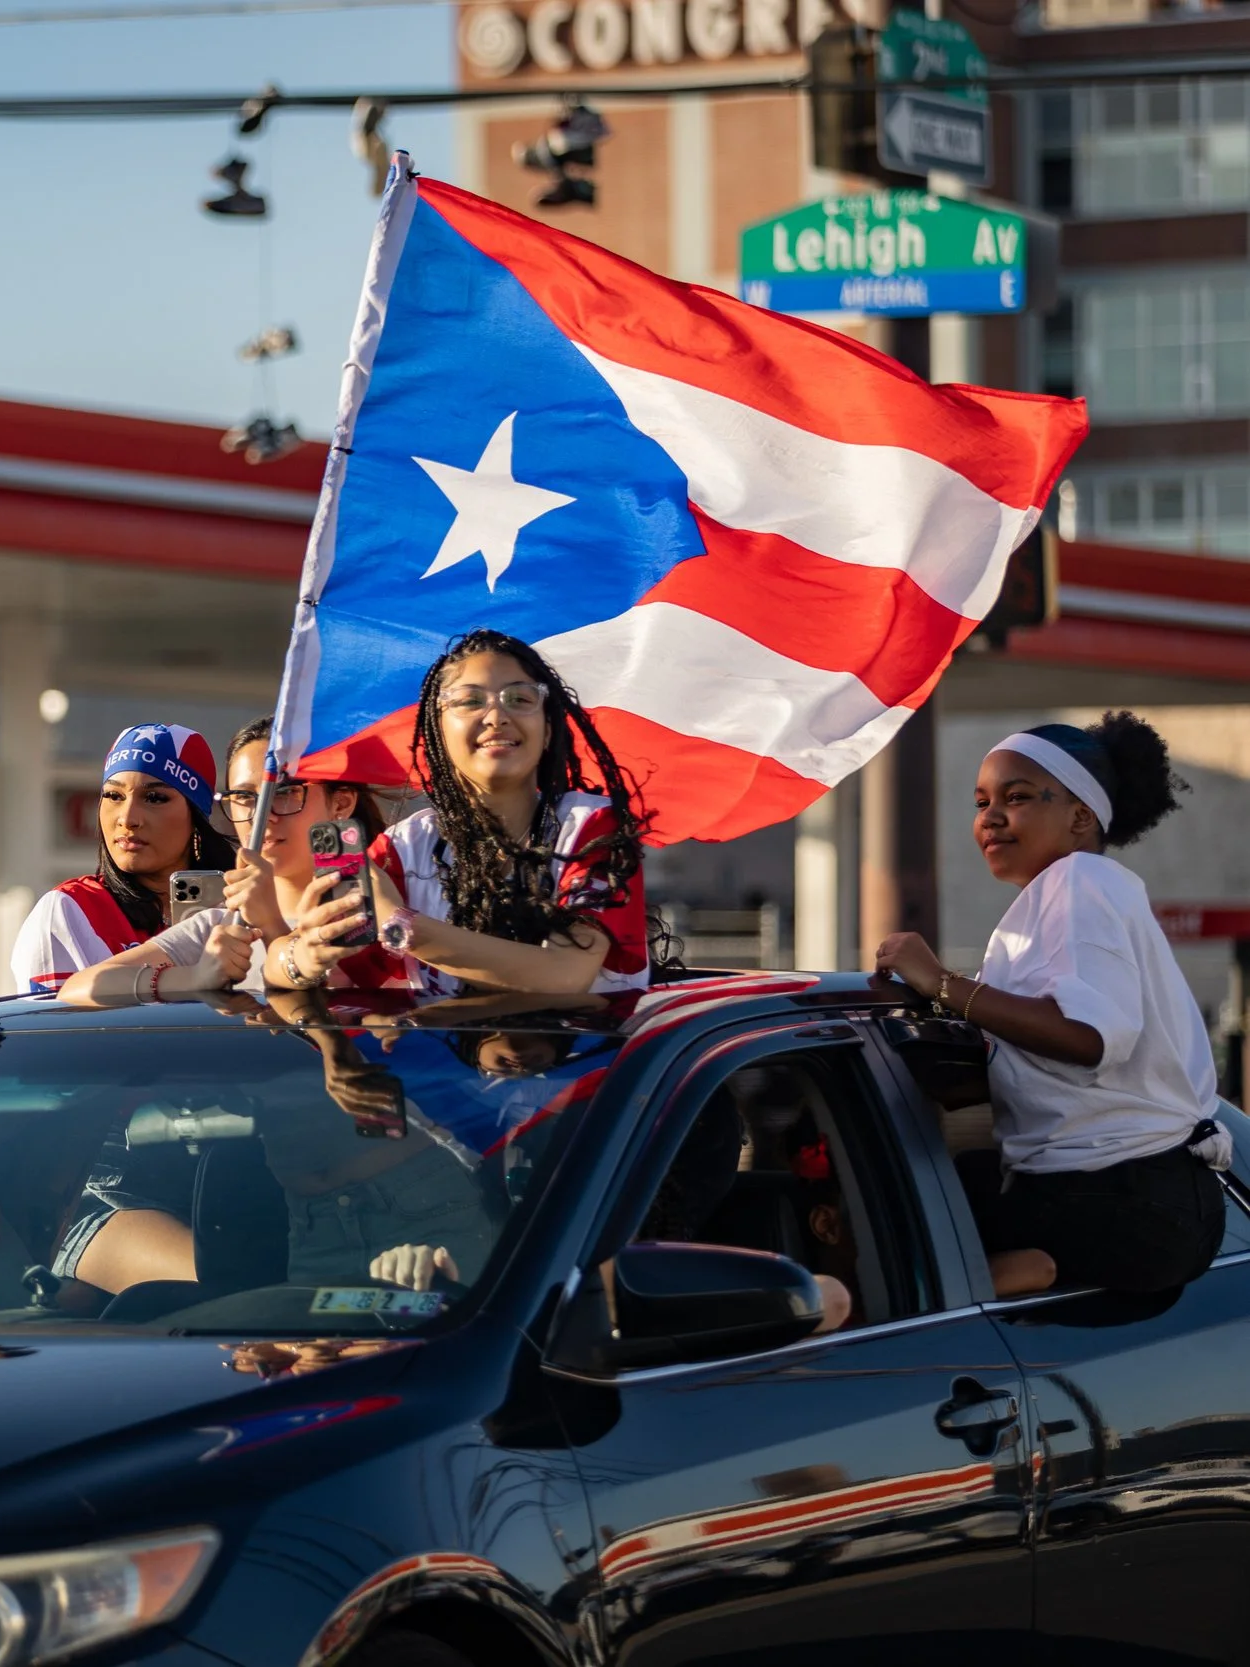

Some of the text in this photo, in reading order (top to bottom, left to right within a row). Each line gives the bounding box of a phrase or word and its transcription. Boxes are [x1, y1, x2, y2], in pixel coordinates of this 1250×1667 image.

[773, 217, 1019, 277] Lehigh Av
[1000, 270, 1016, 308] E
[104, 748, 199, 791] UERTO RICO
